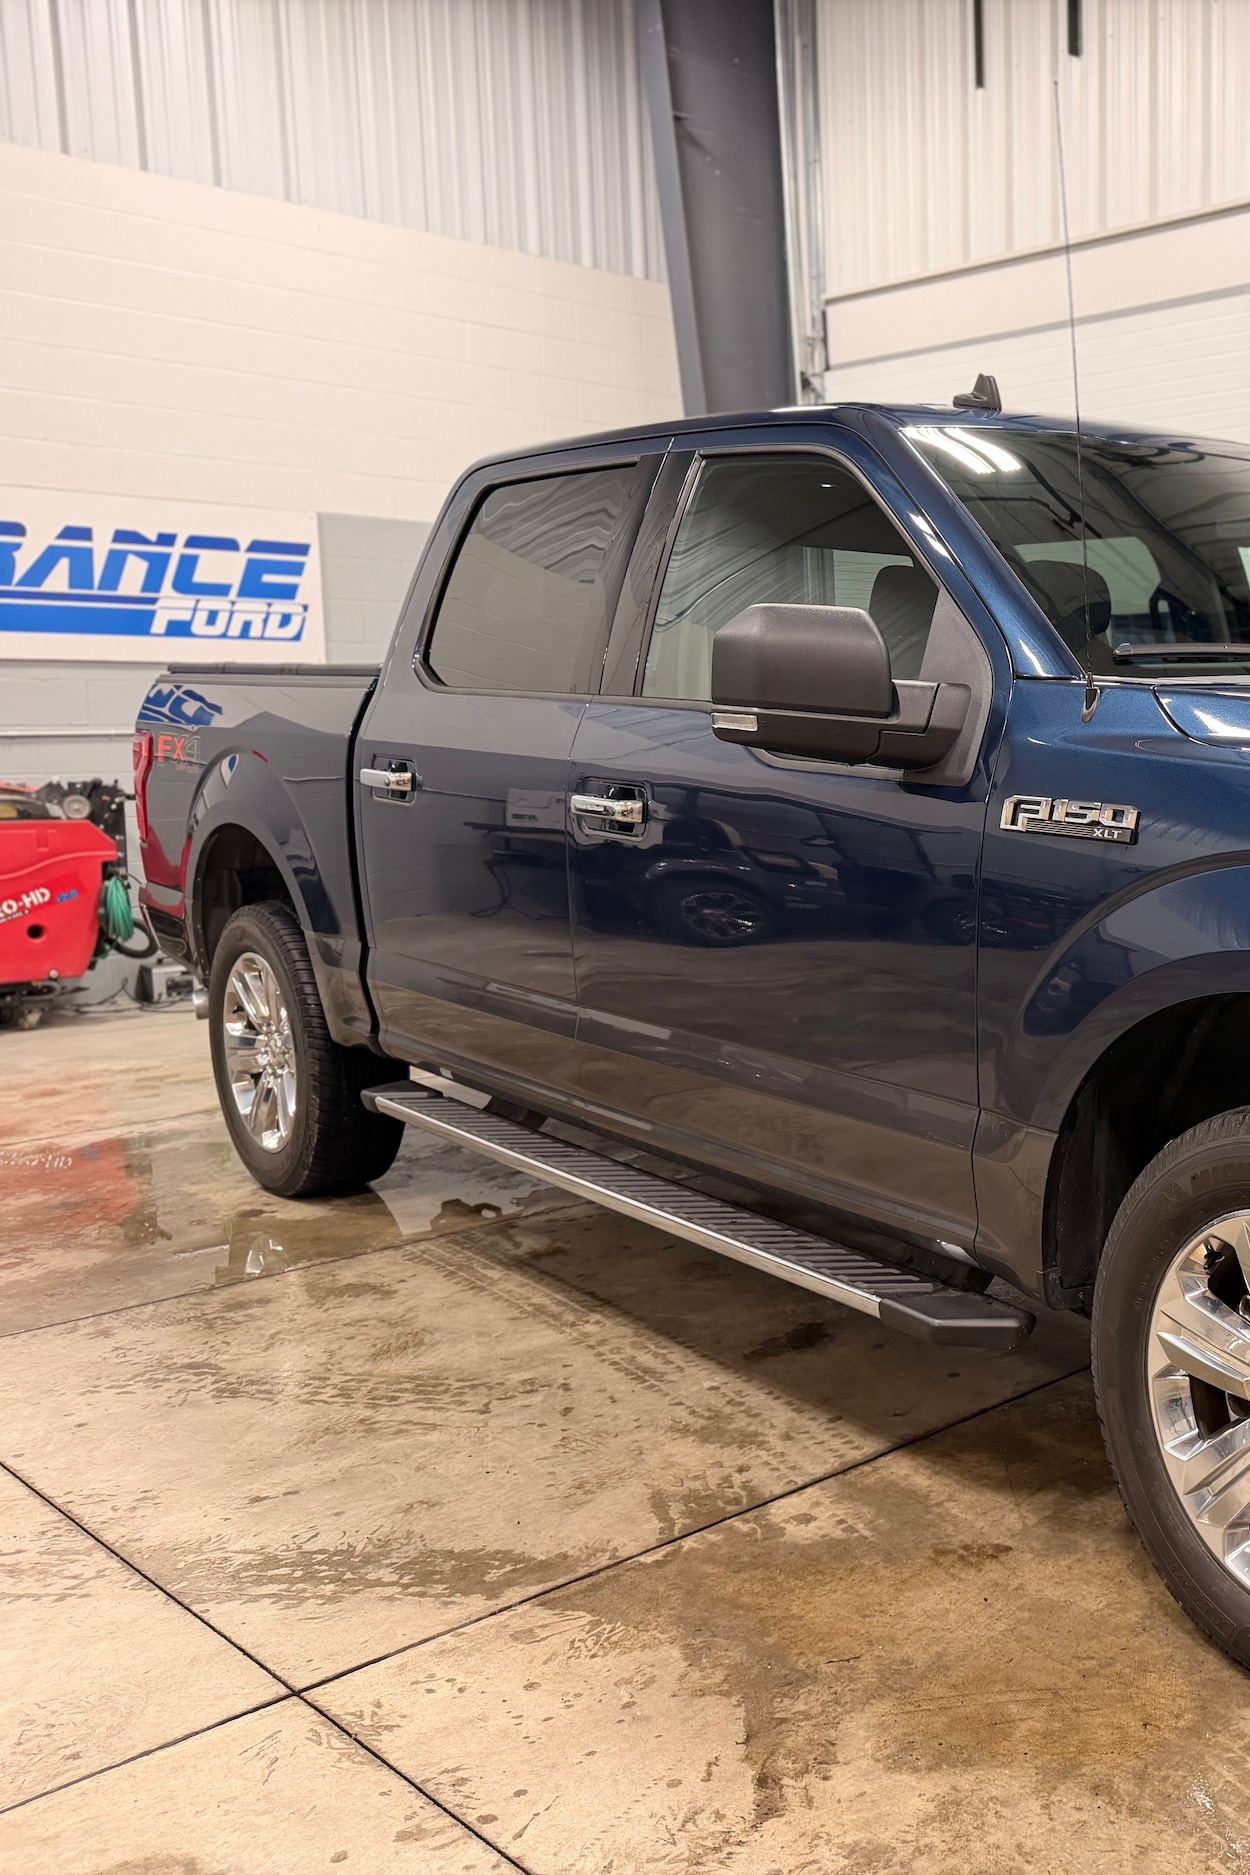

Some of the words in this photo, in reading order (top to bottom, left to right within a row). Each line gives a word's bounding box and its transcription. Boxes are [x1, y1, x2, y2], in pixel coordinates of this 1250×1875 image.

[150, 599, 305, 639] FORD
[157, 731, 201, 767] FX4
[1092, 828, 1122, 839] XLT
